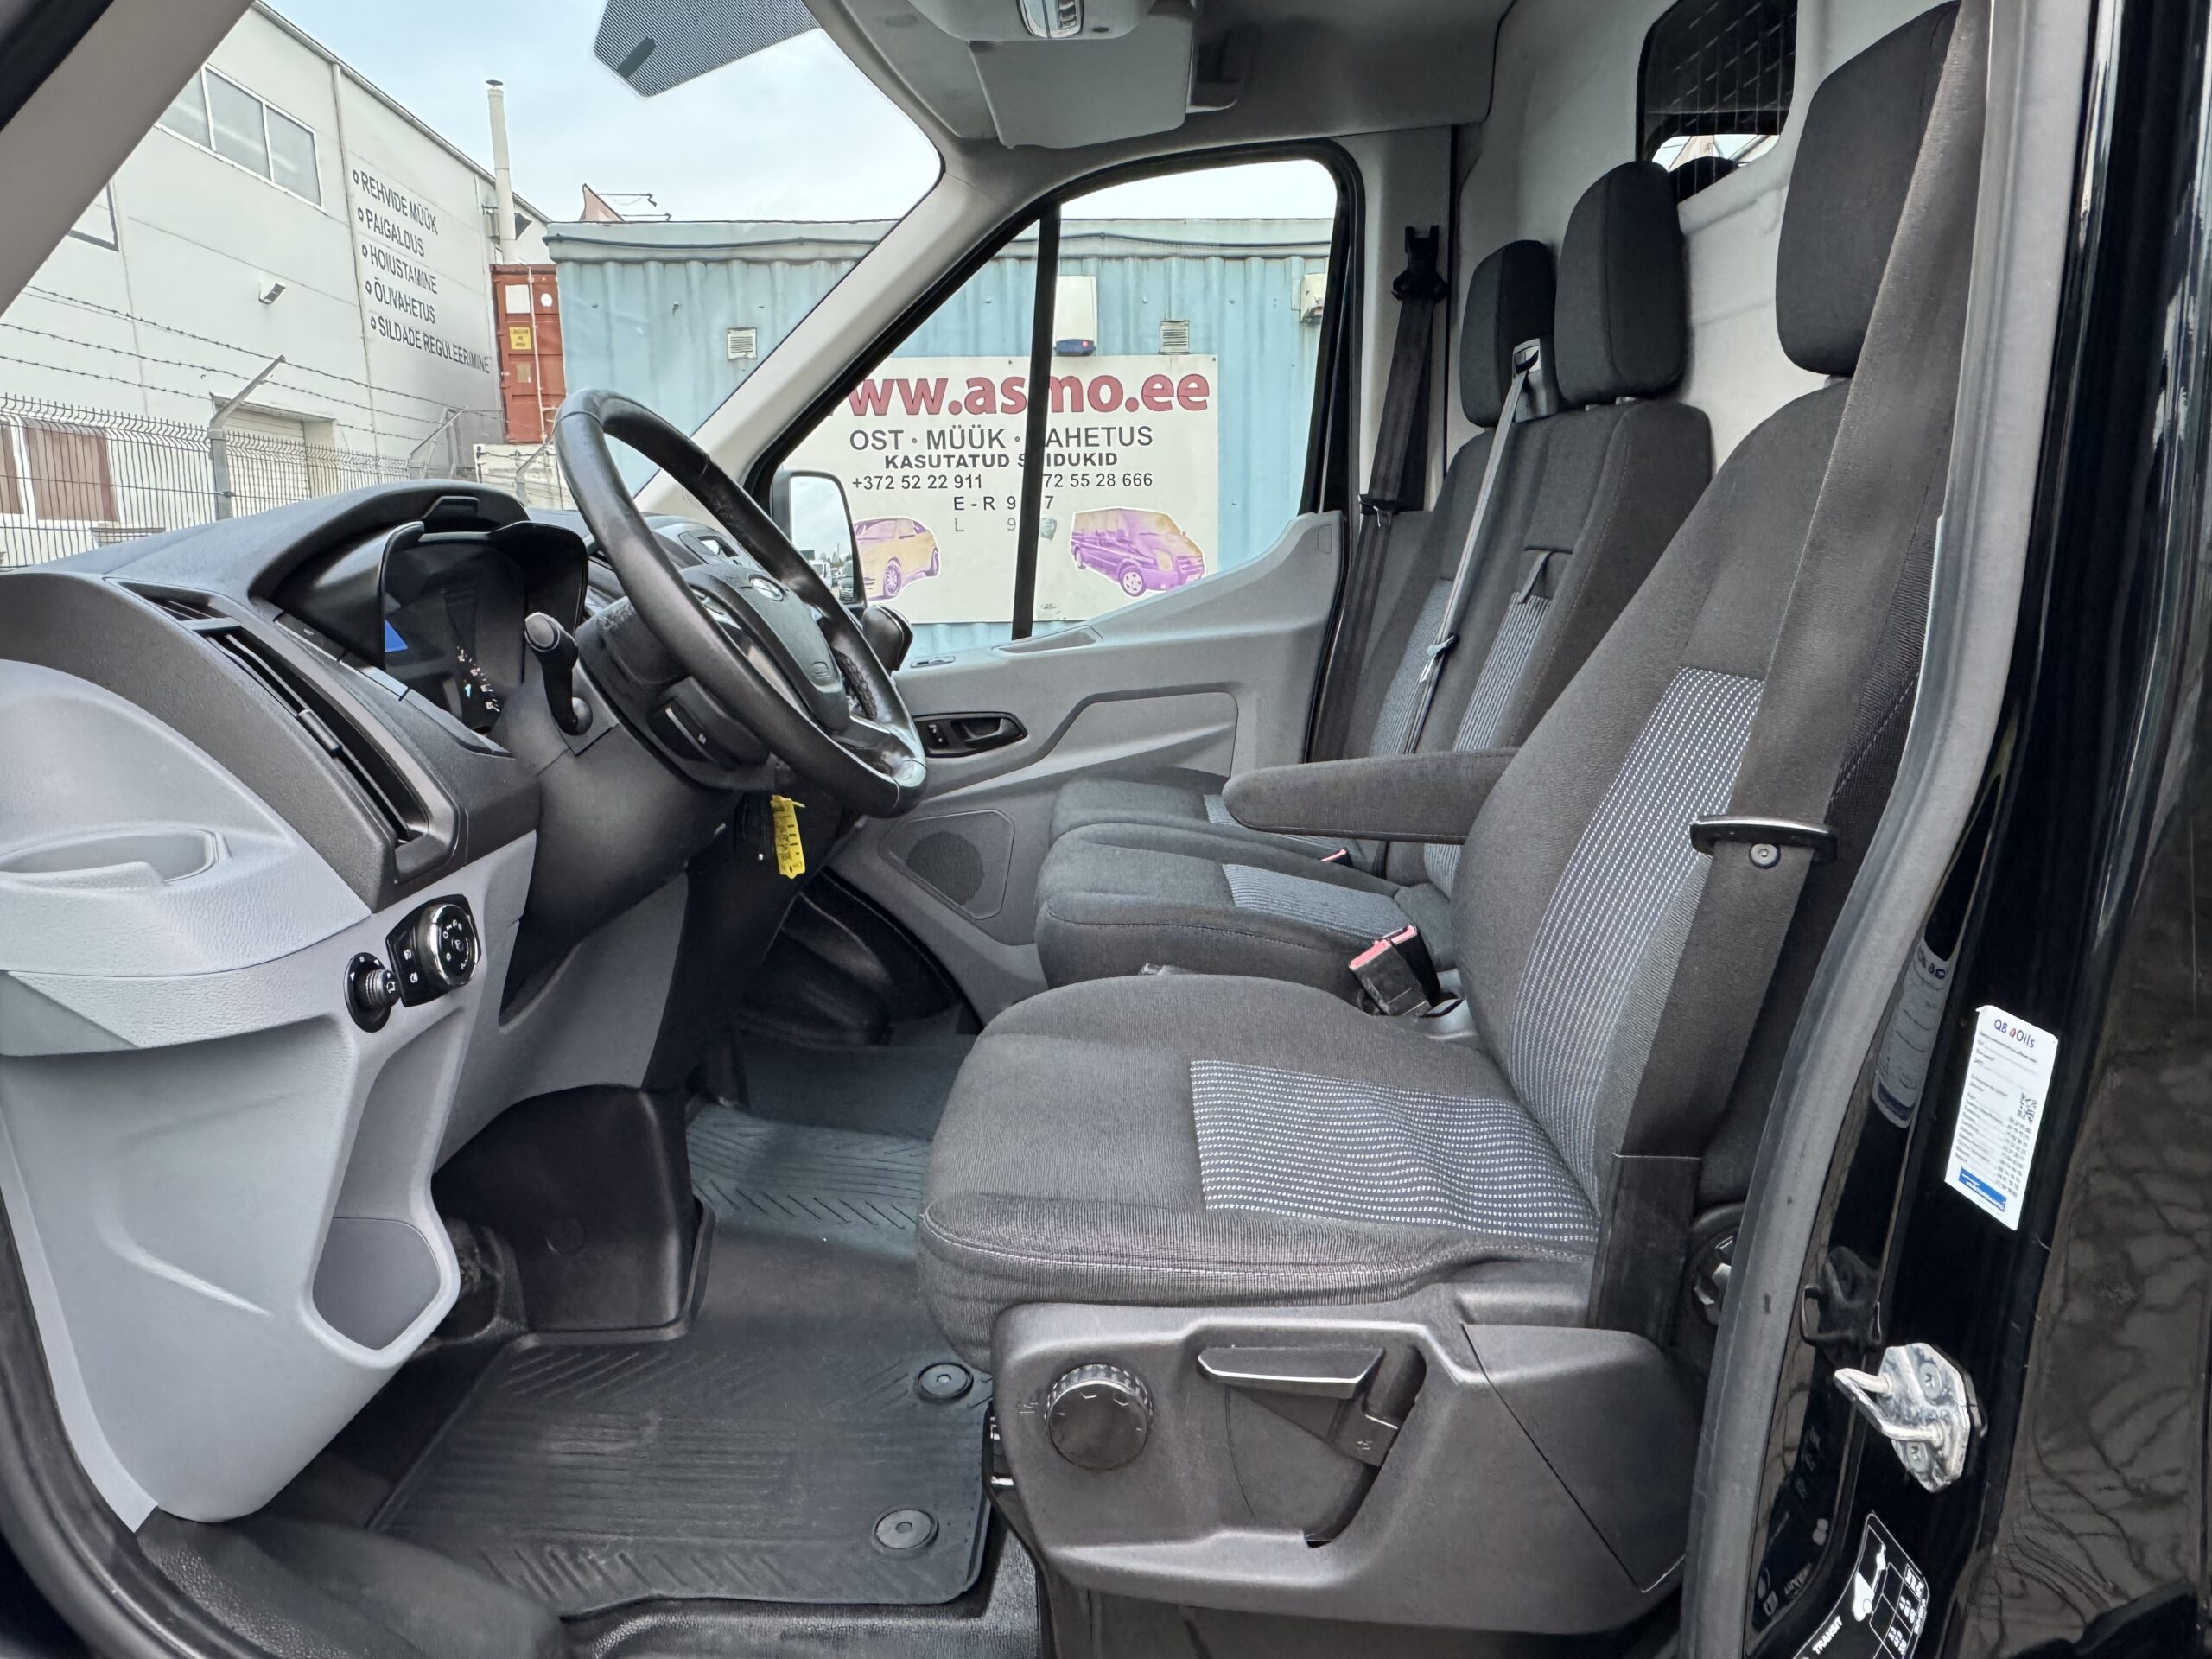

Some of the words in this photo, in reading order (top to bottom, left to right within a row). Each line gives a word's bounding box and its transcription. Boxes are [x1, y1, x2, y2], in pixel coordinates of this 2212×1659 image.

[360, 170, 408, 217] REHVIDE
[410, 200, 438, 235] MÜÜK
[365, 208, 425, 257] PAIGALDUS
[374, 276, 435, 325] ÕLIVAHETUS
[378, 315, 422, 349] SILDADE
[846, 373, 1210, 416] ww.asmo.ee
[849, 429, 904, 450] OST
[926, 423, 1006, 450] MÜÜK
[1044, 425, 1153, 448] AHETUS
[885, 454, 1010, 469] KASUTATUD
[1017, 452, 1118, 467] SIDUKID
[852, 474, 895, 491] +372
[900, 474, 921, 490] 52
[927, 474, 948, 490] 22
[953, 474, 982, 489] 911
[1043, 474, 1064, 488] 72
[1070, 473, 1090, 487] 55
[1096, 473, 1116, 487] 28
[1122, 473, 1153, 486] 666
